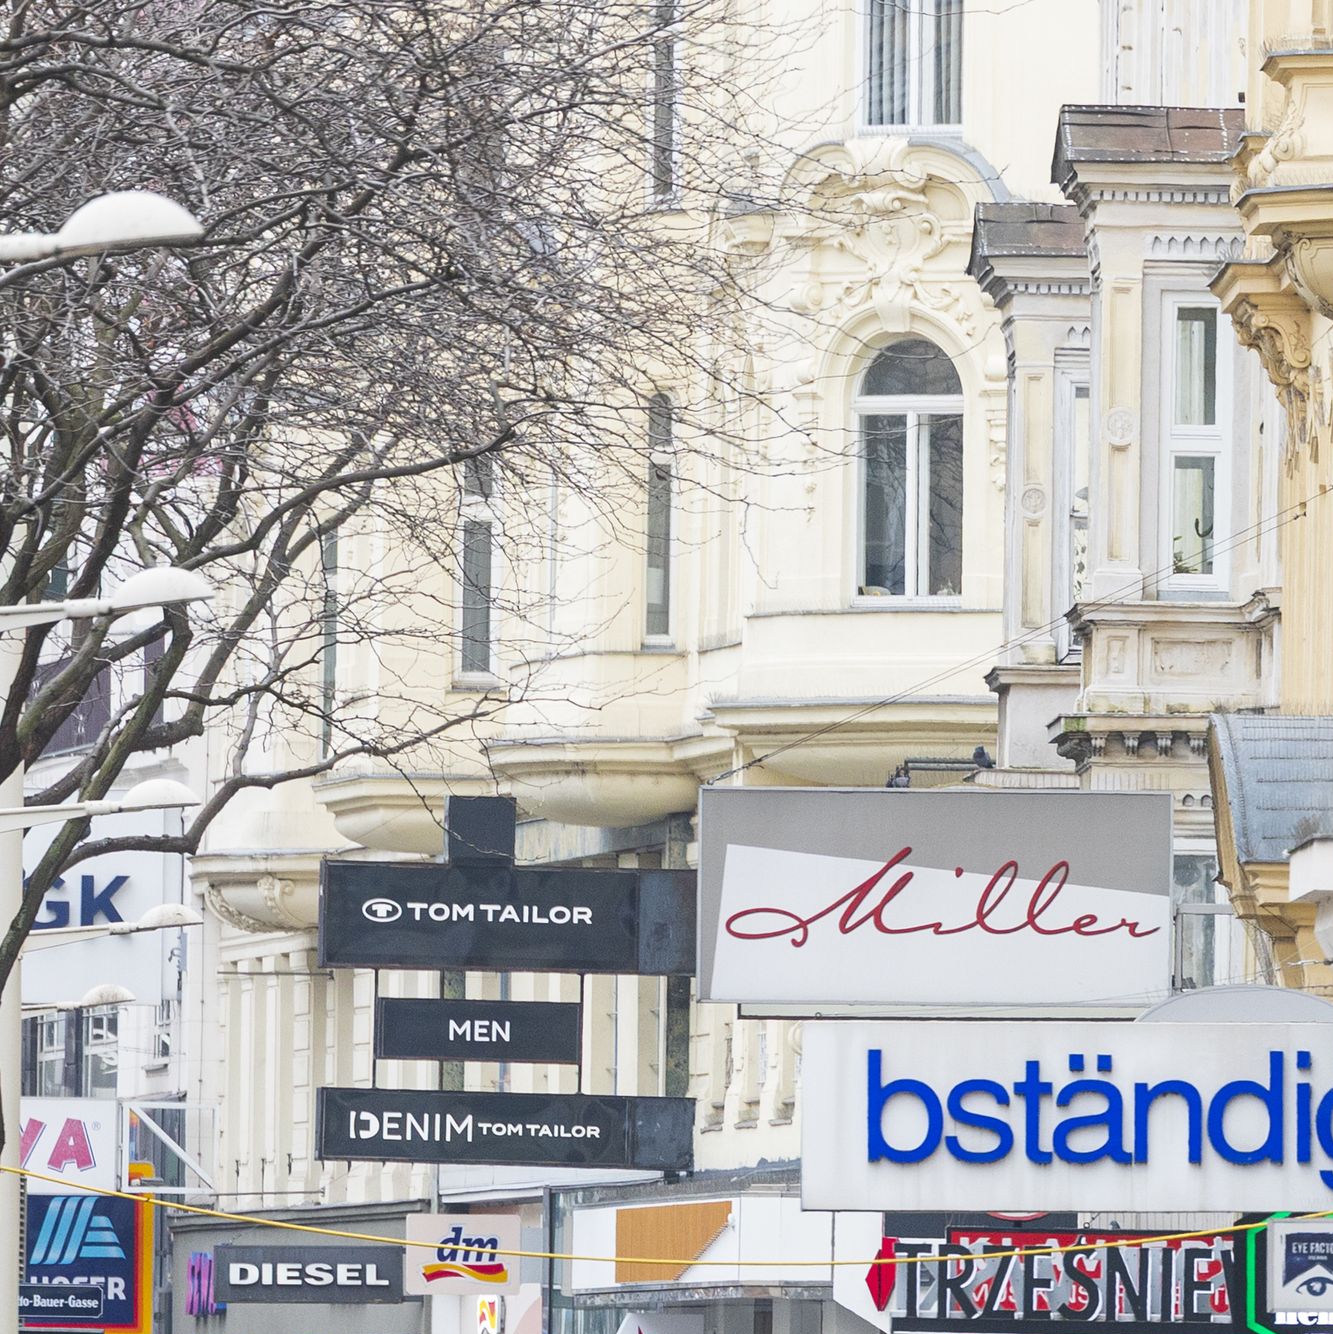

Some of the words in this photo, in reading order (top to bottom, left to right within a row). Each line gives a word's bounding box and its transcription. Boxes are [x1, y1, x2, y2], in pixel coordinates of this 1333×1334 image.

[724, 845, 1163, 949] Miller
[407, 902, 476, 924] TOM
[480, 903, 593, 925] TAILOR
[448, 1020, 511, 1042] MEN
[349, 1110, 473, 1142] DENIM
[478, 1123, 522, 1136] TOM
[526, 1125, 601, 1138] TAILOR
[436, 1226, 499, 1264] dm
[1291, 1241, 1309, 1254] EYE
[229, 1262, 390, 1287] DIESEL
[893, 1234, 1236, 1322] TRZEŚNIE
